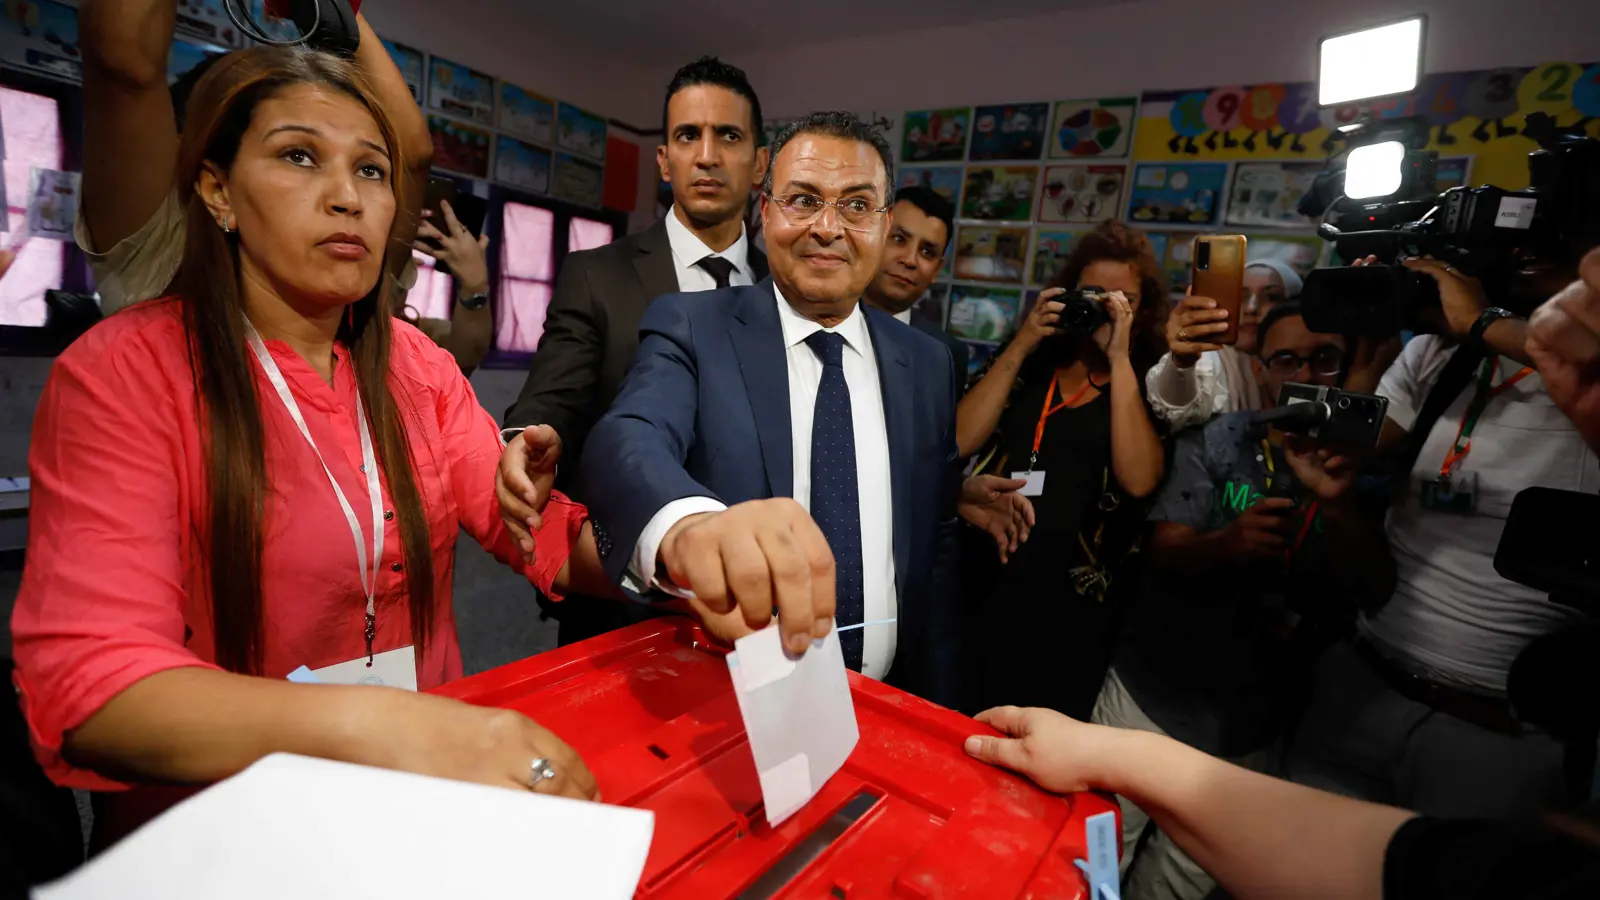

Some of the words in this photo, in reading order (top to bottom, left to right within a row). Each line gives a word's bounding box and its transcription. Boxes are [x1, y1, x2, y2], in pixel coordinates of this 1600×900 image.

[1217, 93, 1239, 125] 9
[1253, 90, 1276, 120] 8
[1295, 91, 1315, 124] 7
[1433, 80, 1457, 116] 4
[1484, 73, 1513, 103] 3
[1538, 65, 1571, 101] 2
